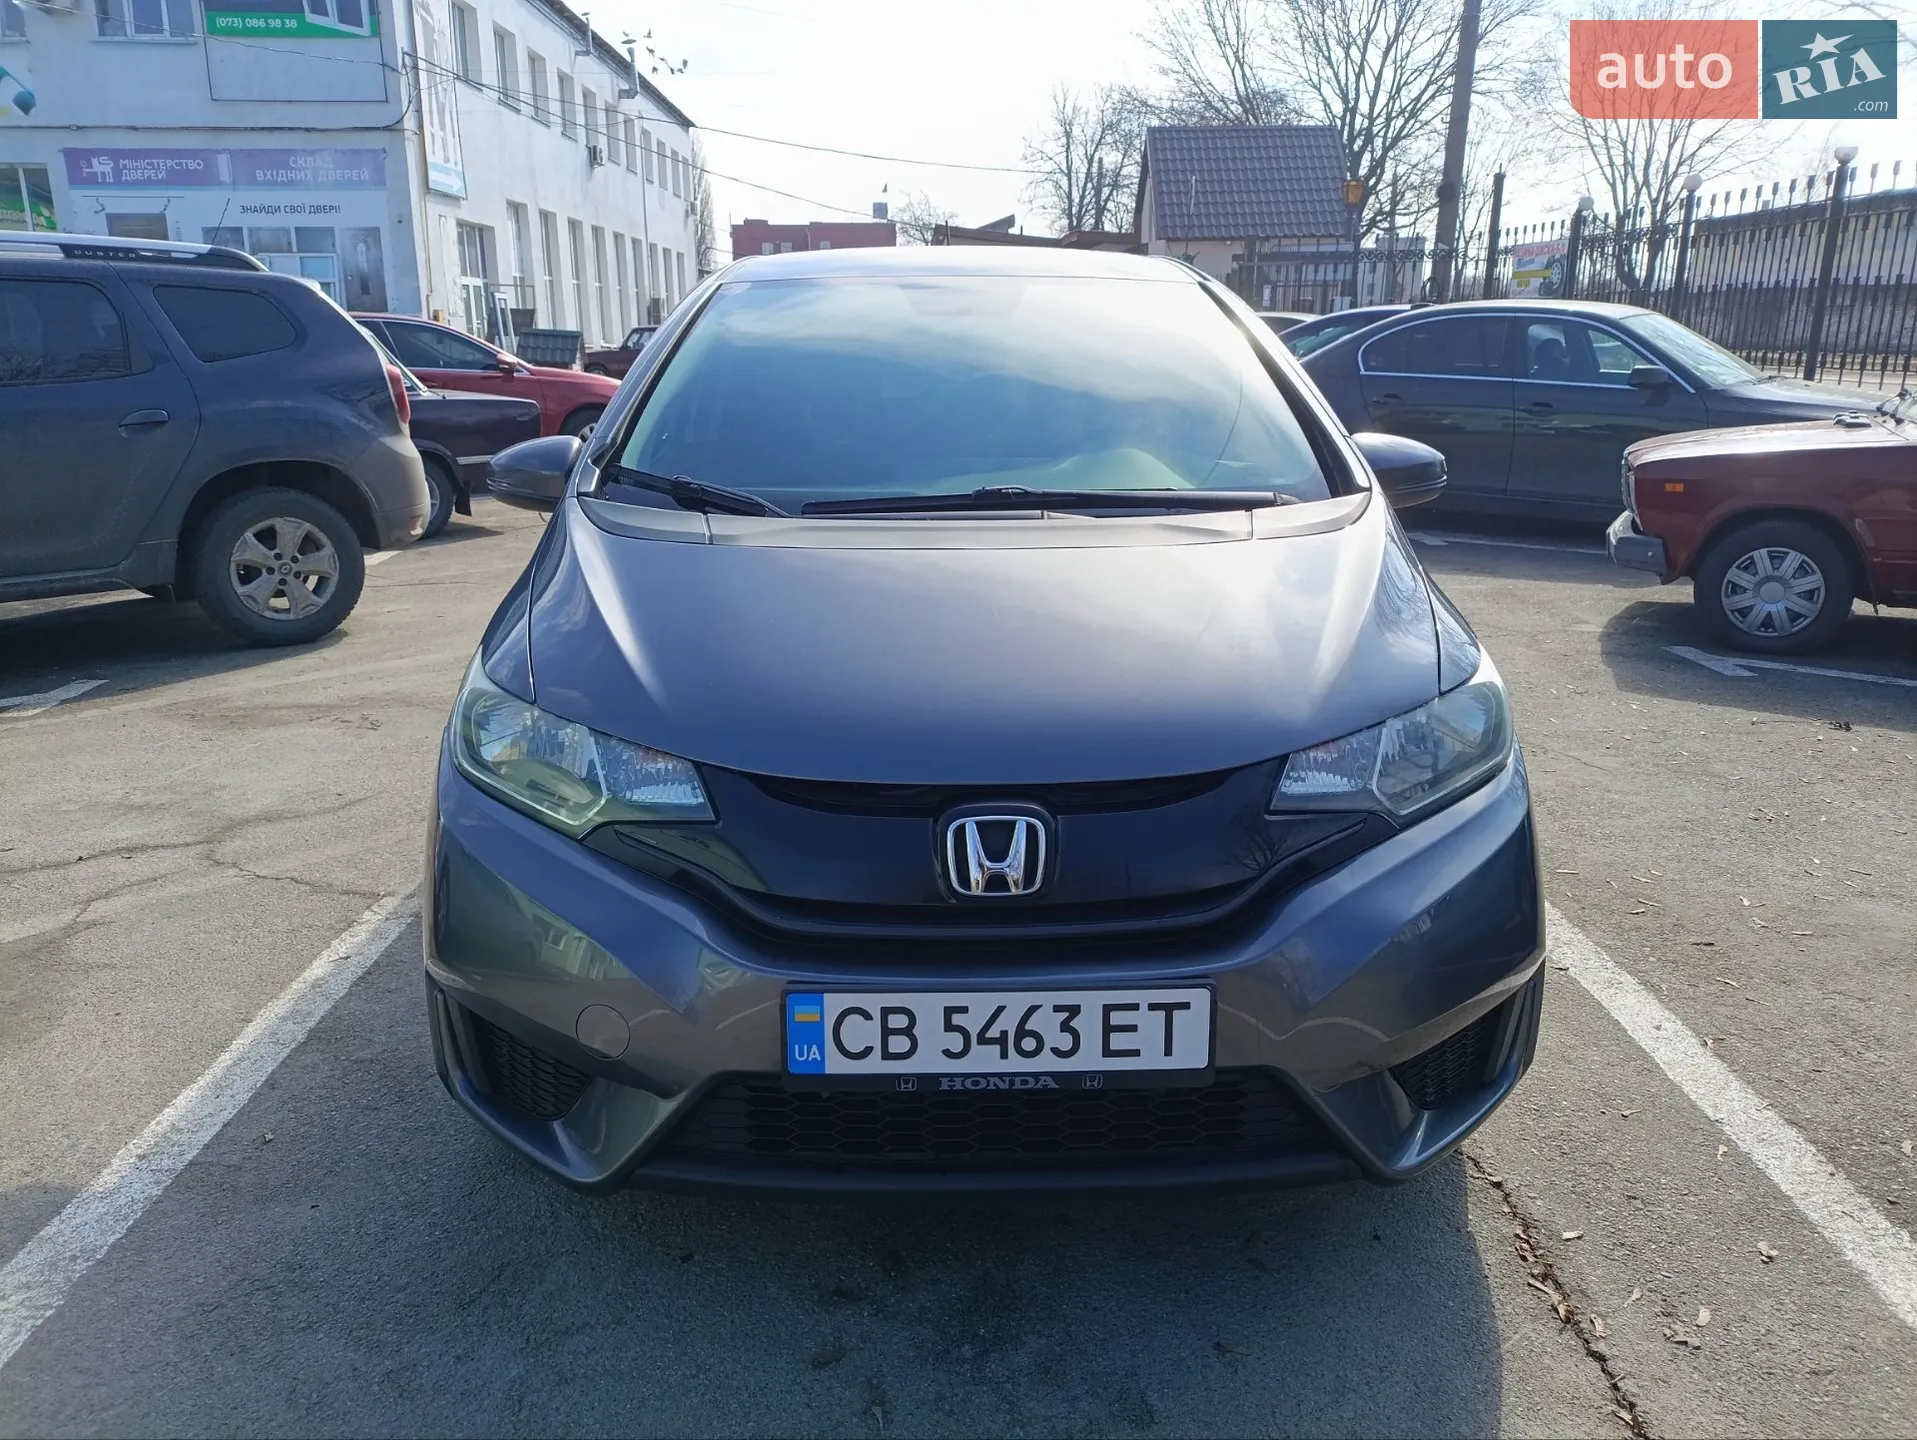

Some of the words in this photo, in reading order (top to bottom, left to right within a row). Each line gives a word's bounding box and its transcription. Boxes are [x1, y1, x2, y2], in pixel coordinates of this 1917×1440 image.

[216, 16, 243, 29] (073)
[245, 18, 266, 28] 086
[268, 18, 282, 28] 98
[284, 18, 298, 29] 38
[119, 159, 204, 170] МІНІСТЕРСТВО
[289, 156, 334, 168] СКЛАД
[121, 168, 167, 181] ДВЕРЕЙ
[255, 169, 313, 183] ВХІДНИХ
[317, 167, 370, 183] ДВЕРЕЙ
[240, 203, 281, 215] ЗНАЙДИ
[283, 203, 306, 214] СВОЇ
[308, 204, 341, 215] ДВЕРІ!
[832, 1006, 919, 1061] CB
[941, 1004, 1082, 1060] 5463
[1101, 1001, 1191, 1058] ET
[794, 1044, 821, 1062] UA
[938, 1075, 1060, 1091] HONDA
